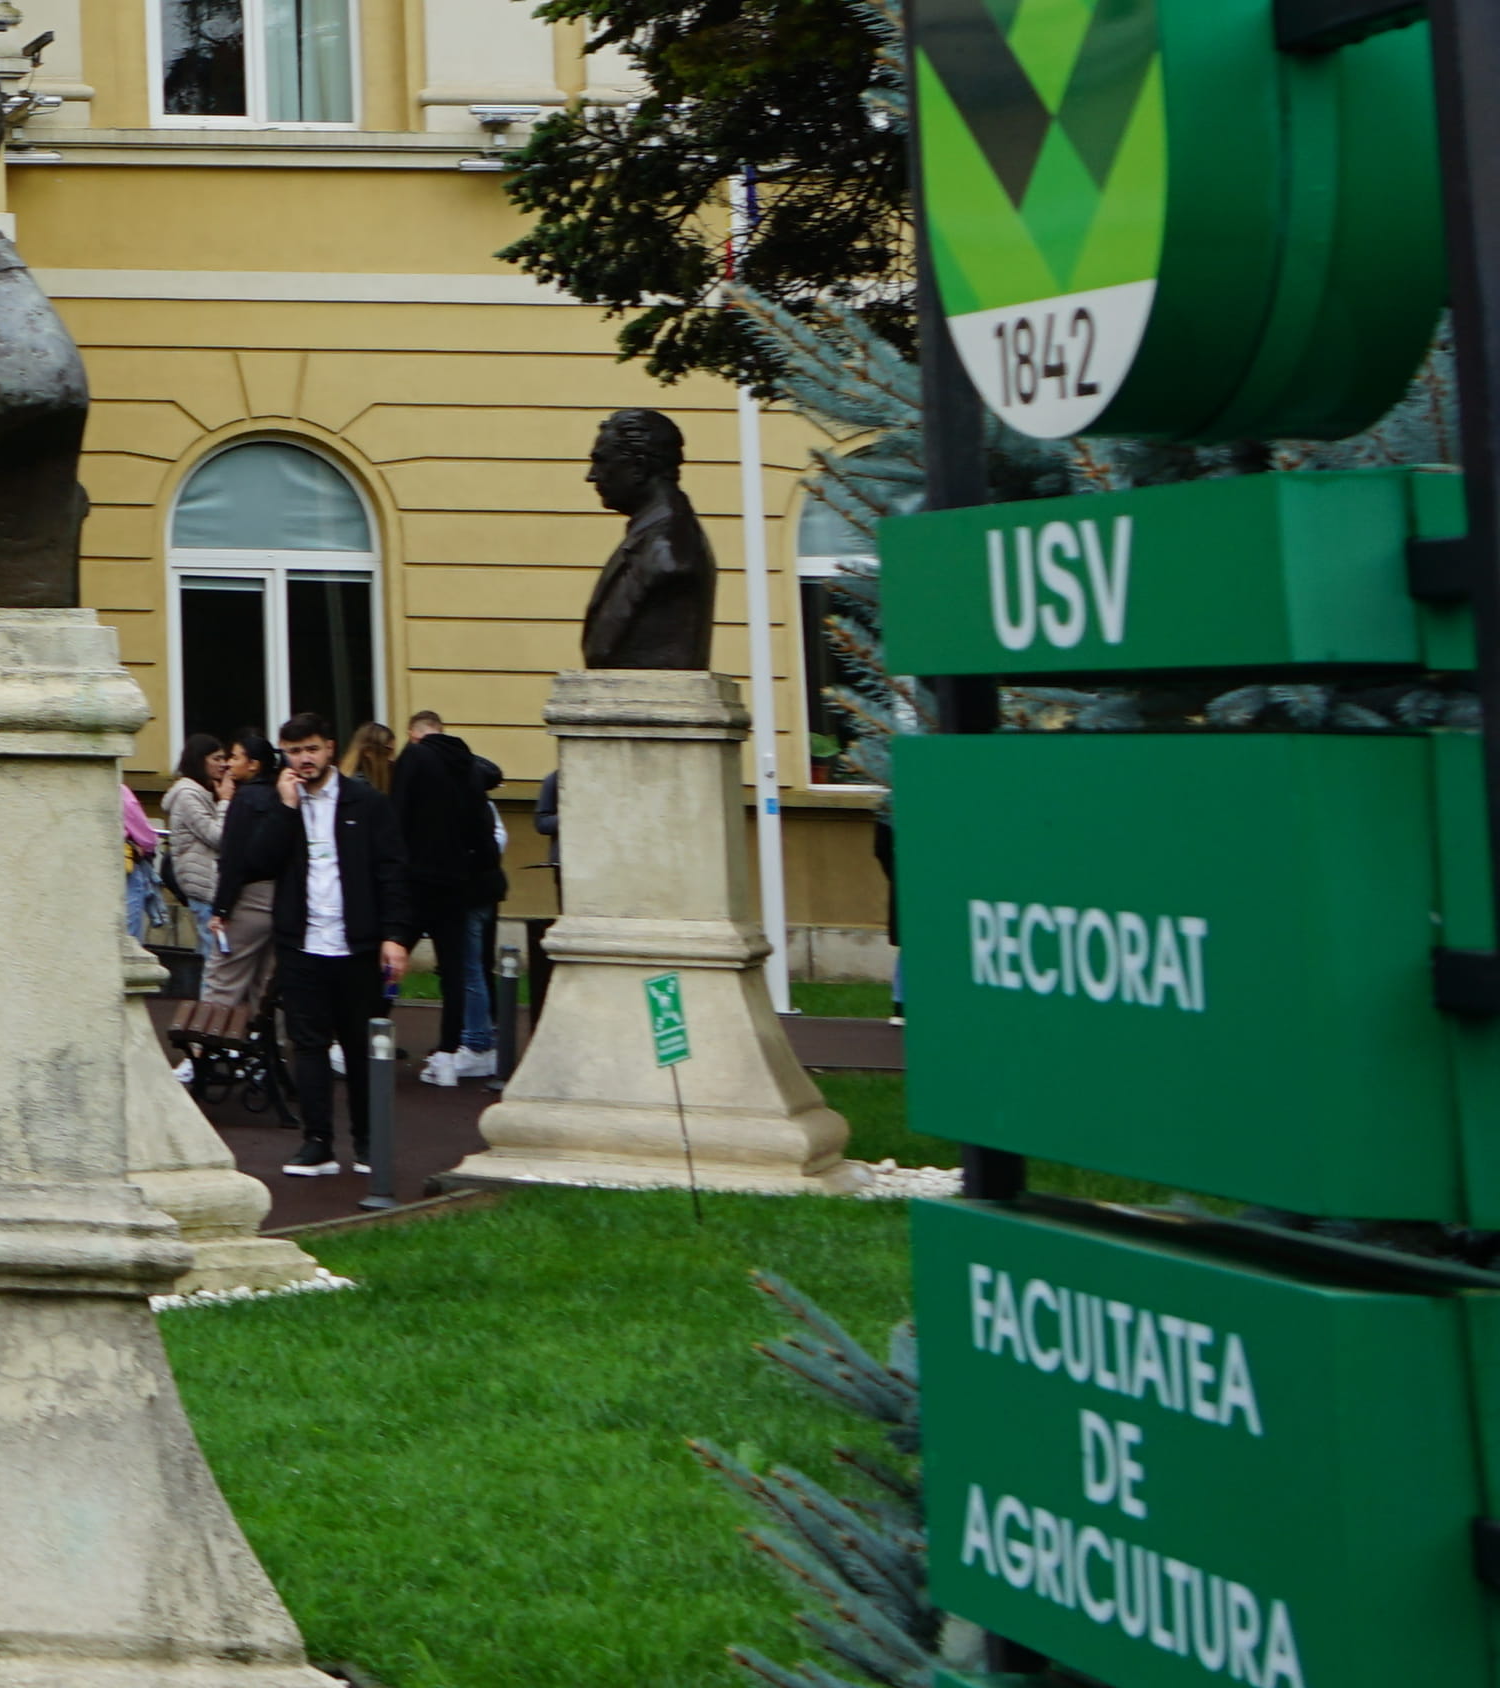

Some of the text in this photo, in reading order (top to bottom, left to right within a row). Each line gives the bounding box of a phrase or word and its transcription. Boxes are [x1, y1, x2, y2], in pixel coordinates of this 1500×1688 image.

[991, 307, 1101, 409] 1842
[986, 515, 1134, 650] USV
[968, 899, 1209, 1013] RECTORAT
[969, 1263, 1264, 1437] FACULTATEA
[1080, 1408, 1148, 1519] DE
[960, 1483, 1306, 1688] AGRICULTURA
